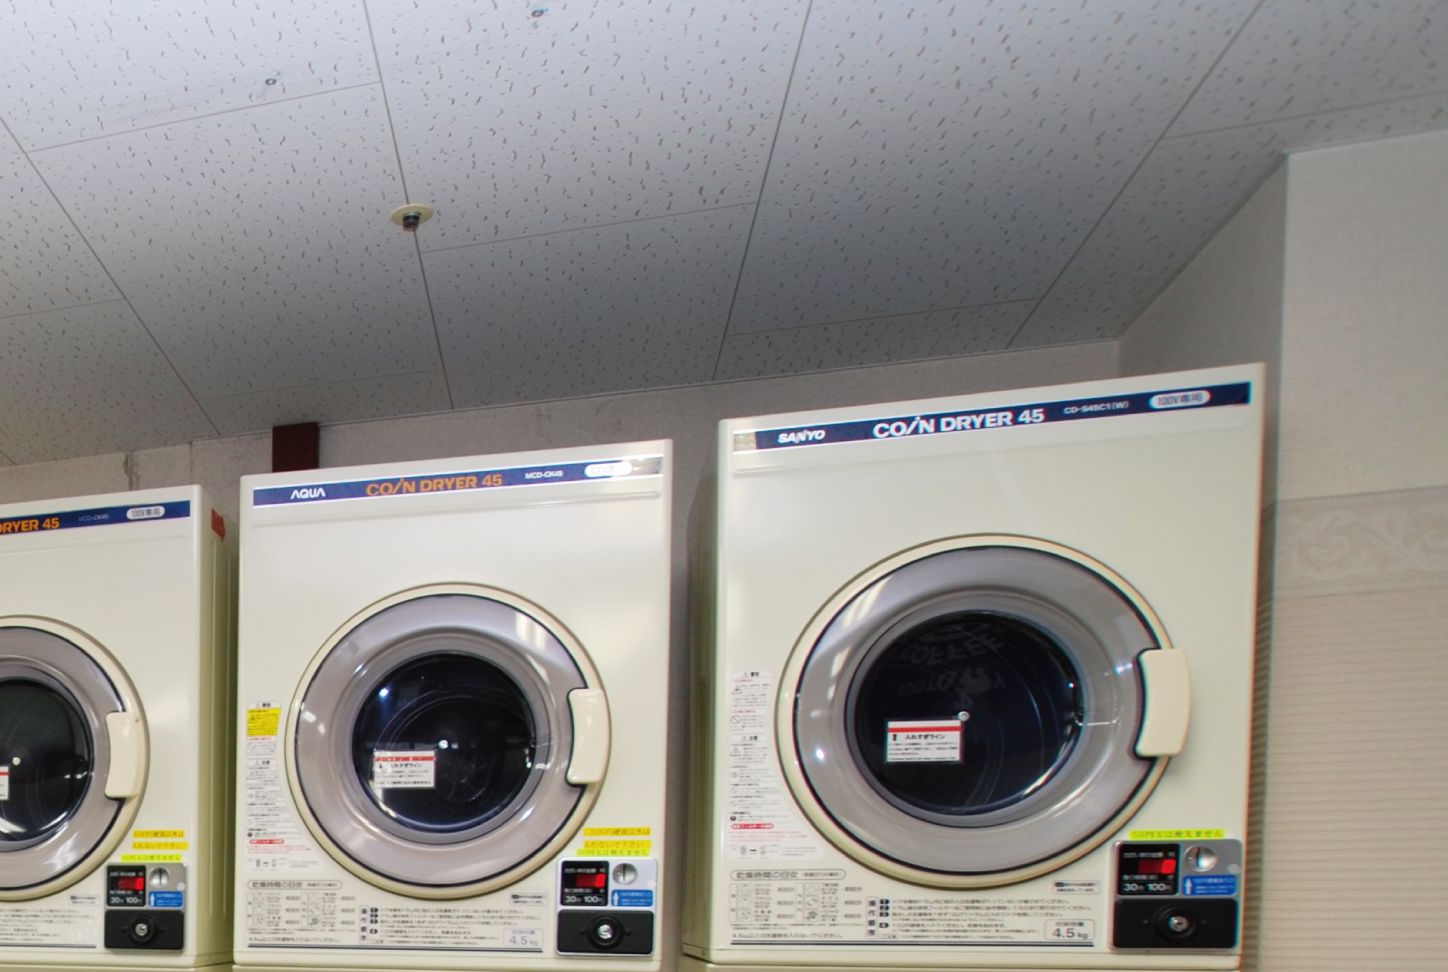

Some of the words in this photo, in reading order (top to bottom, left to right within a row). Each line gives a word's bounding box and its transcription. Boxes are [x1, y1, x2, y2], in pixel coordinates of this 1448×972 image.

[778, 429, 825, 444] SANYO
[940, 410, 1013, 433] DRYER
[1017, 408, 1044, 424] 45
[290, 487, 326, 500] AQUA
[420, 474, 477, 493] DRYER
[481, 473, 503, 487] 45
[42, 517, 60, 530] 45
[1052, 927, 1076, 939] 4.5
